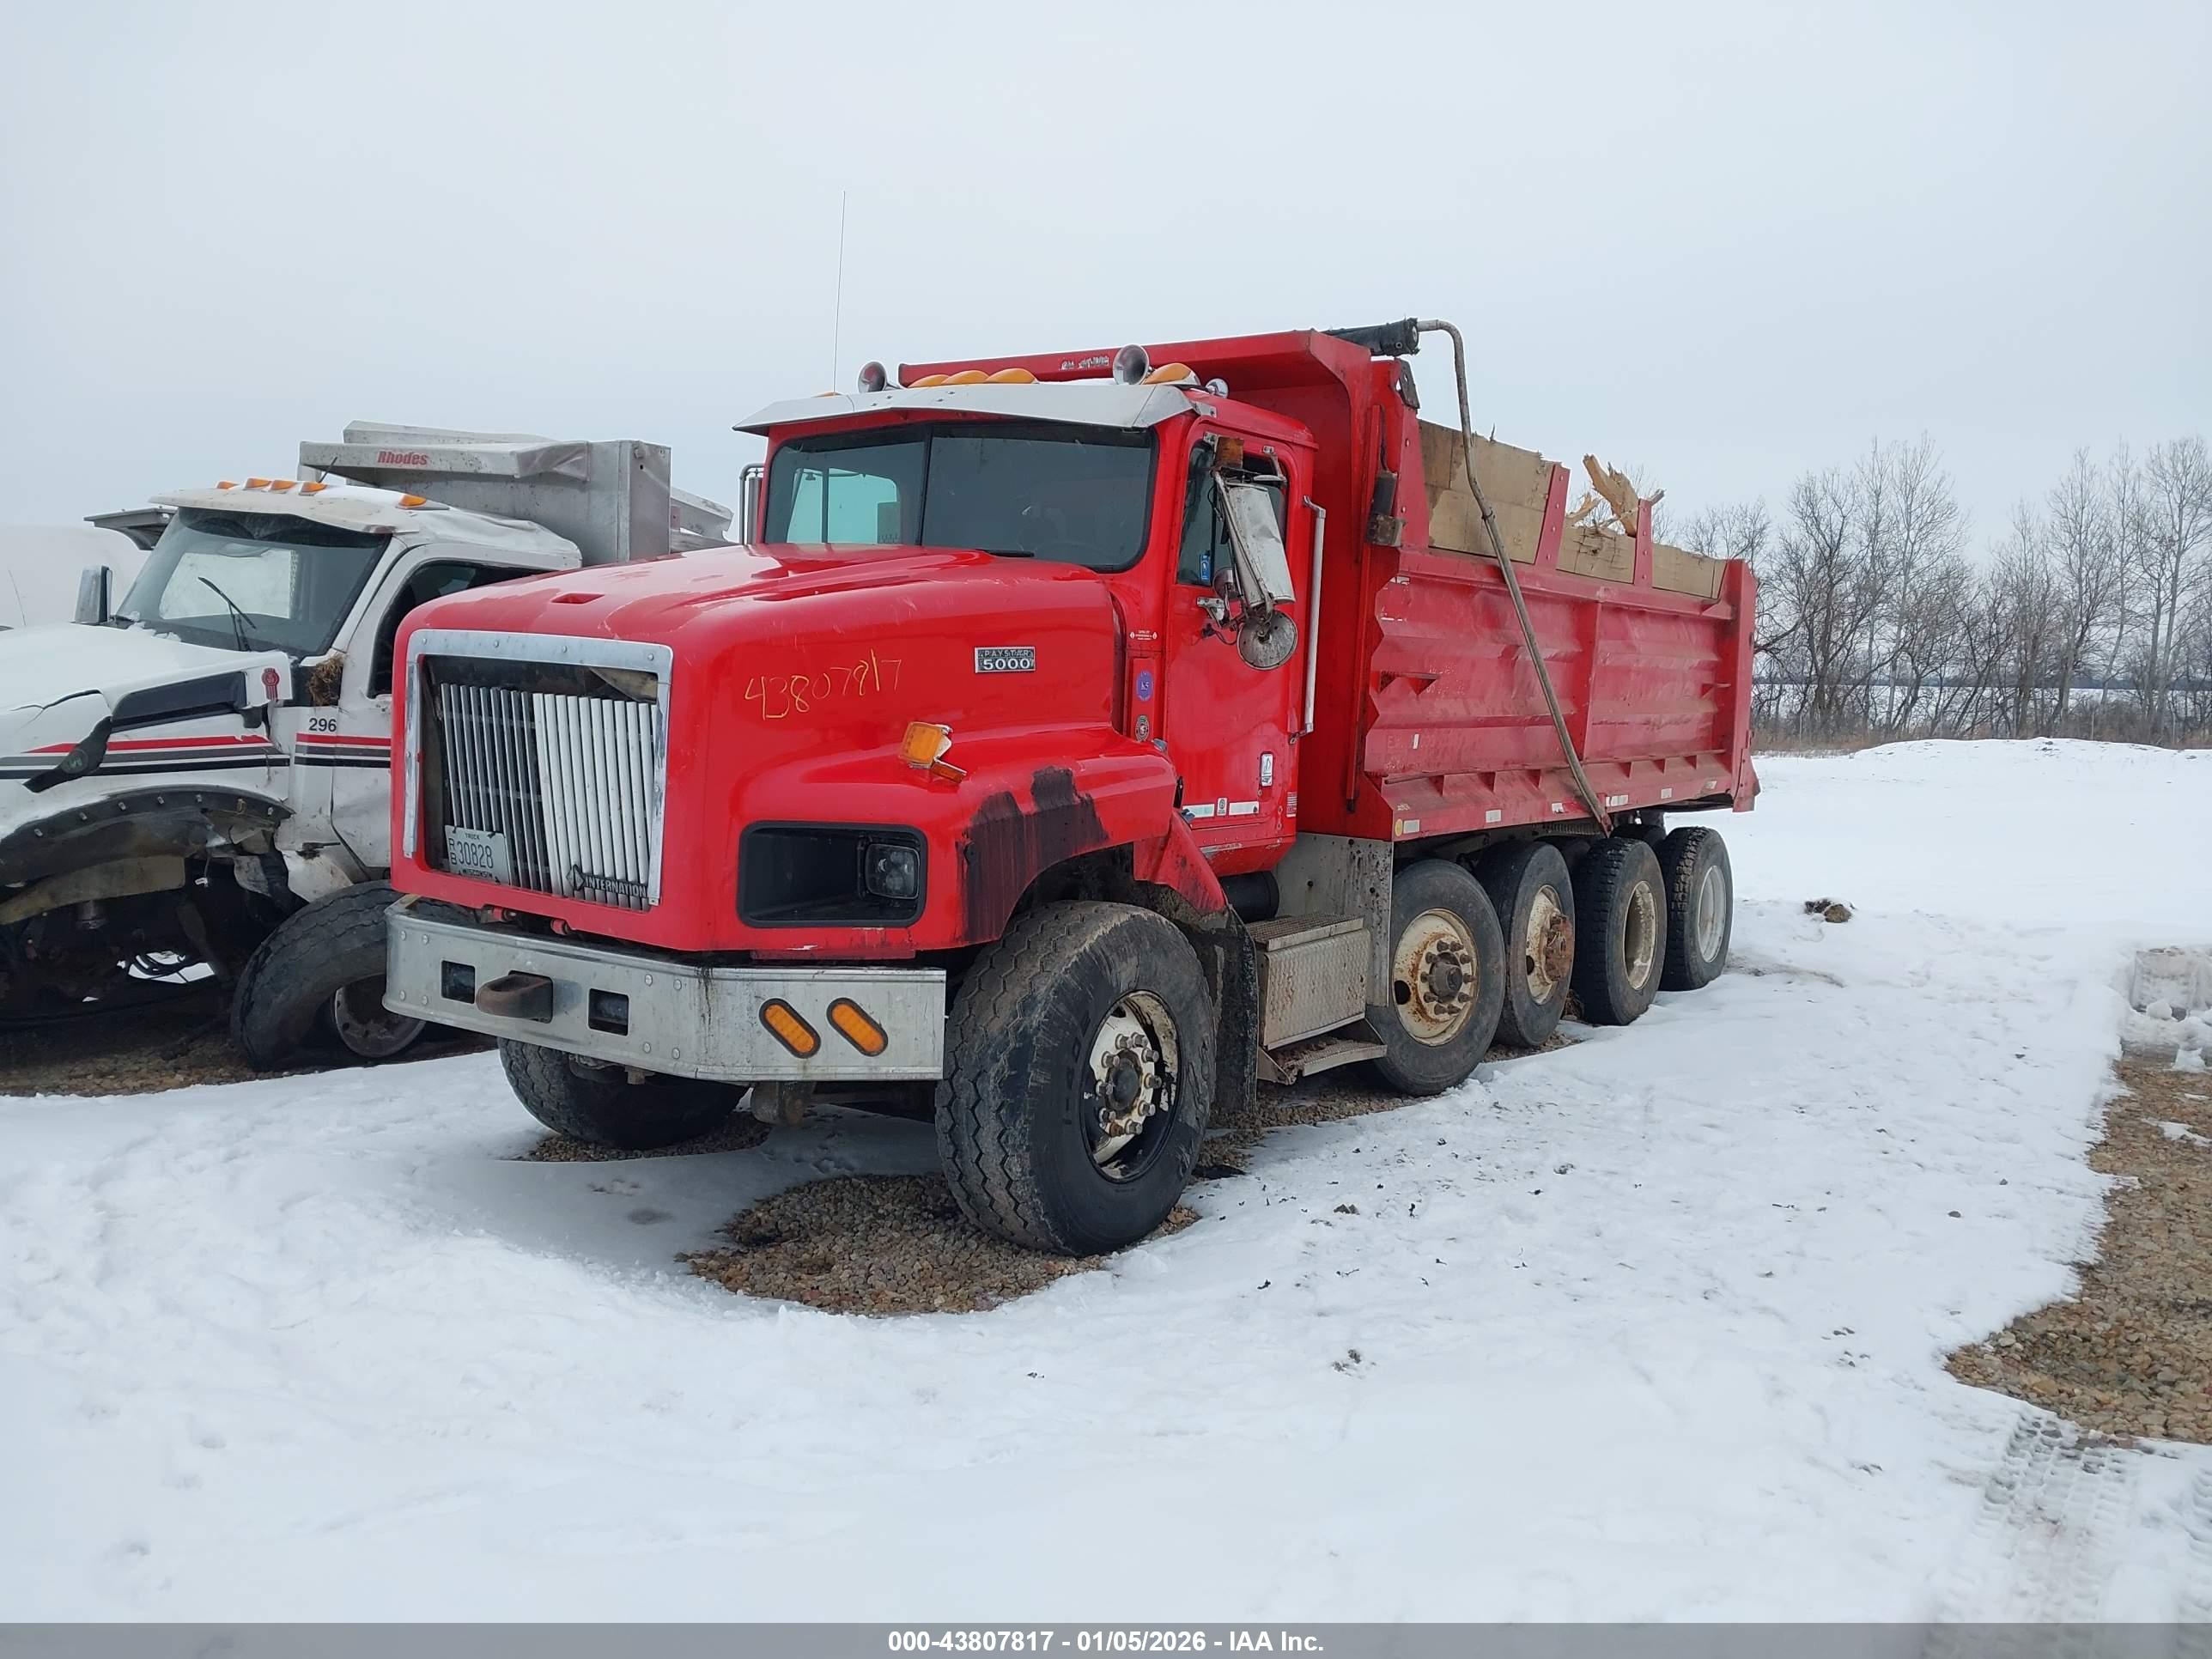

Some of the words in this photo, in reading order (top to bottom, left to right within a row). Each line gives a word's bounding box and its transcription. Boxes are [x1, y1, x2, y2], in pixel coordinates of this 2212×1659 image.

[378, 451, 428, 465] Rhodes
[983, 658, 1030, 671] 5000
[744, 648, 902, 720] 43807817
[309, 717, 337, 732] 296
[457, 841, 494, 869] 30828
